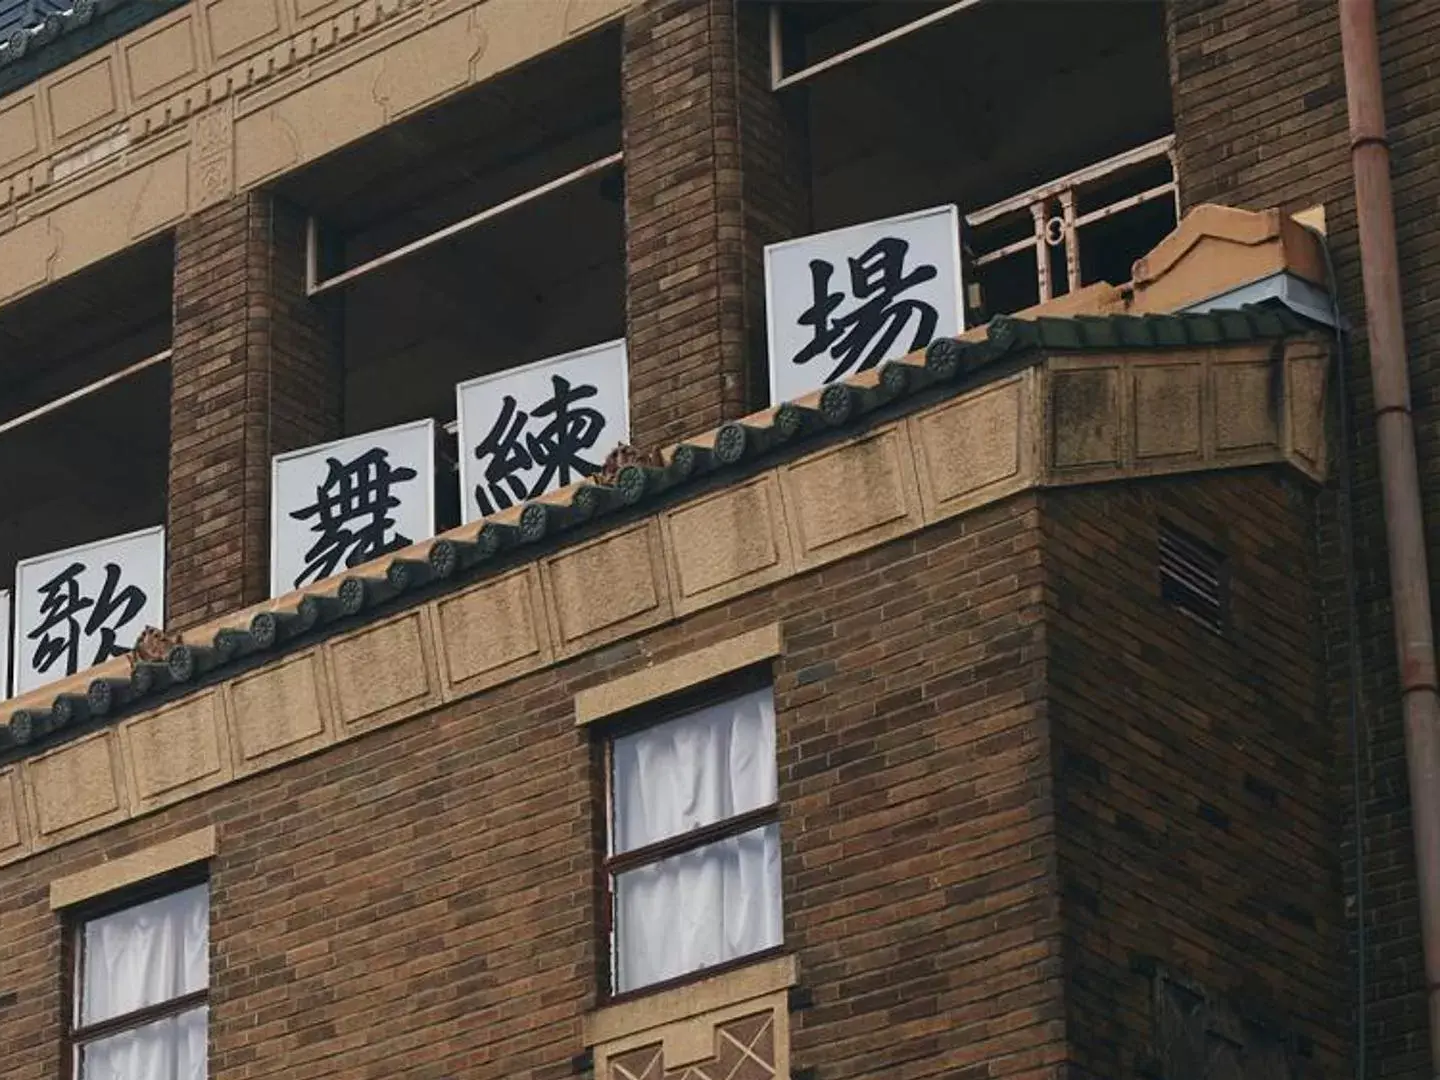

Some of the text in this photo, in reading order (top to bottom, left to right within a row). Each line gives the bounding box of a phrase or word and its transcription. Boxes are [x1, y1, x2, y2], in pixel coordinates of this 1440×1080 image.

[27, 562, 147, 676] 歌
[290, 447, 418, 589] 舞
[474, 374, 606, 517] 練
[791, 237, 939, 384] 場
